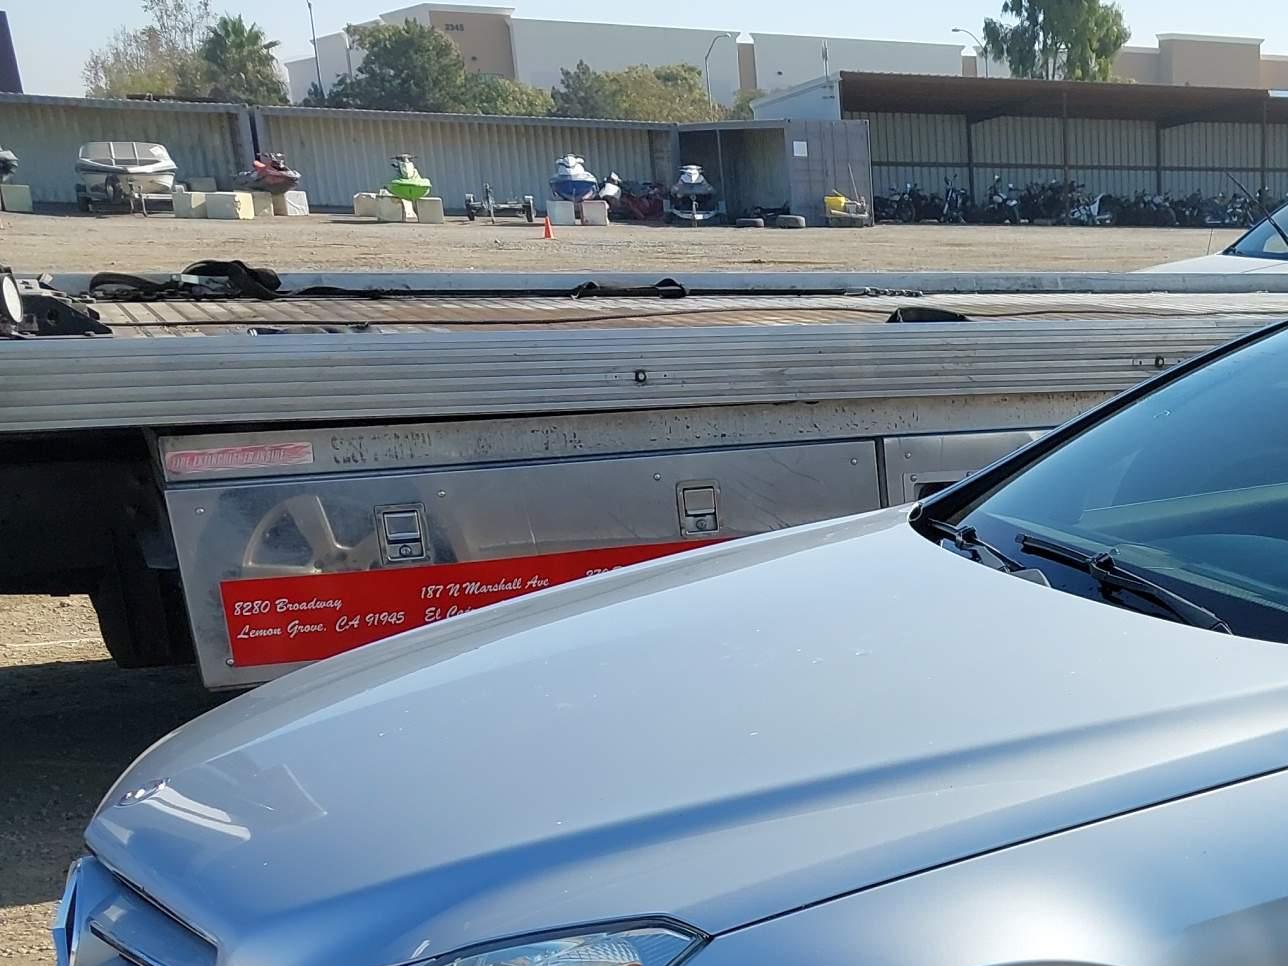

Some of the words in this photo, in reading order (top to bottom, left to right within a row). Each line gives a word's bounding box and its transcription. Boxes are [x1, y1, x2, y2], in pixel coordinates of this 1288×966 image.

[421, 586, 444, 600] 187
[447, 583, 460, 597] N
[462, 577, 522, 595] Marshall
[234, 600, 271, 616] 8280
[275, 598, 342, 612] Broadway
[425, 607, 441, 621] El
[237, 625, 281, 639] Lemon
[335, 614, 360, 632] CA
[365, 611, 405, 627] 91945
